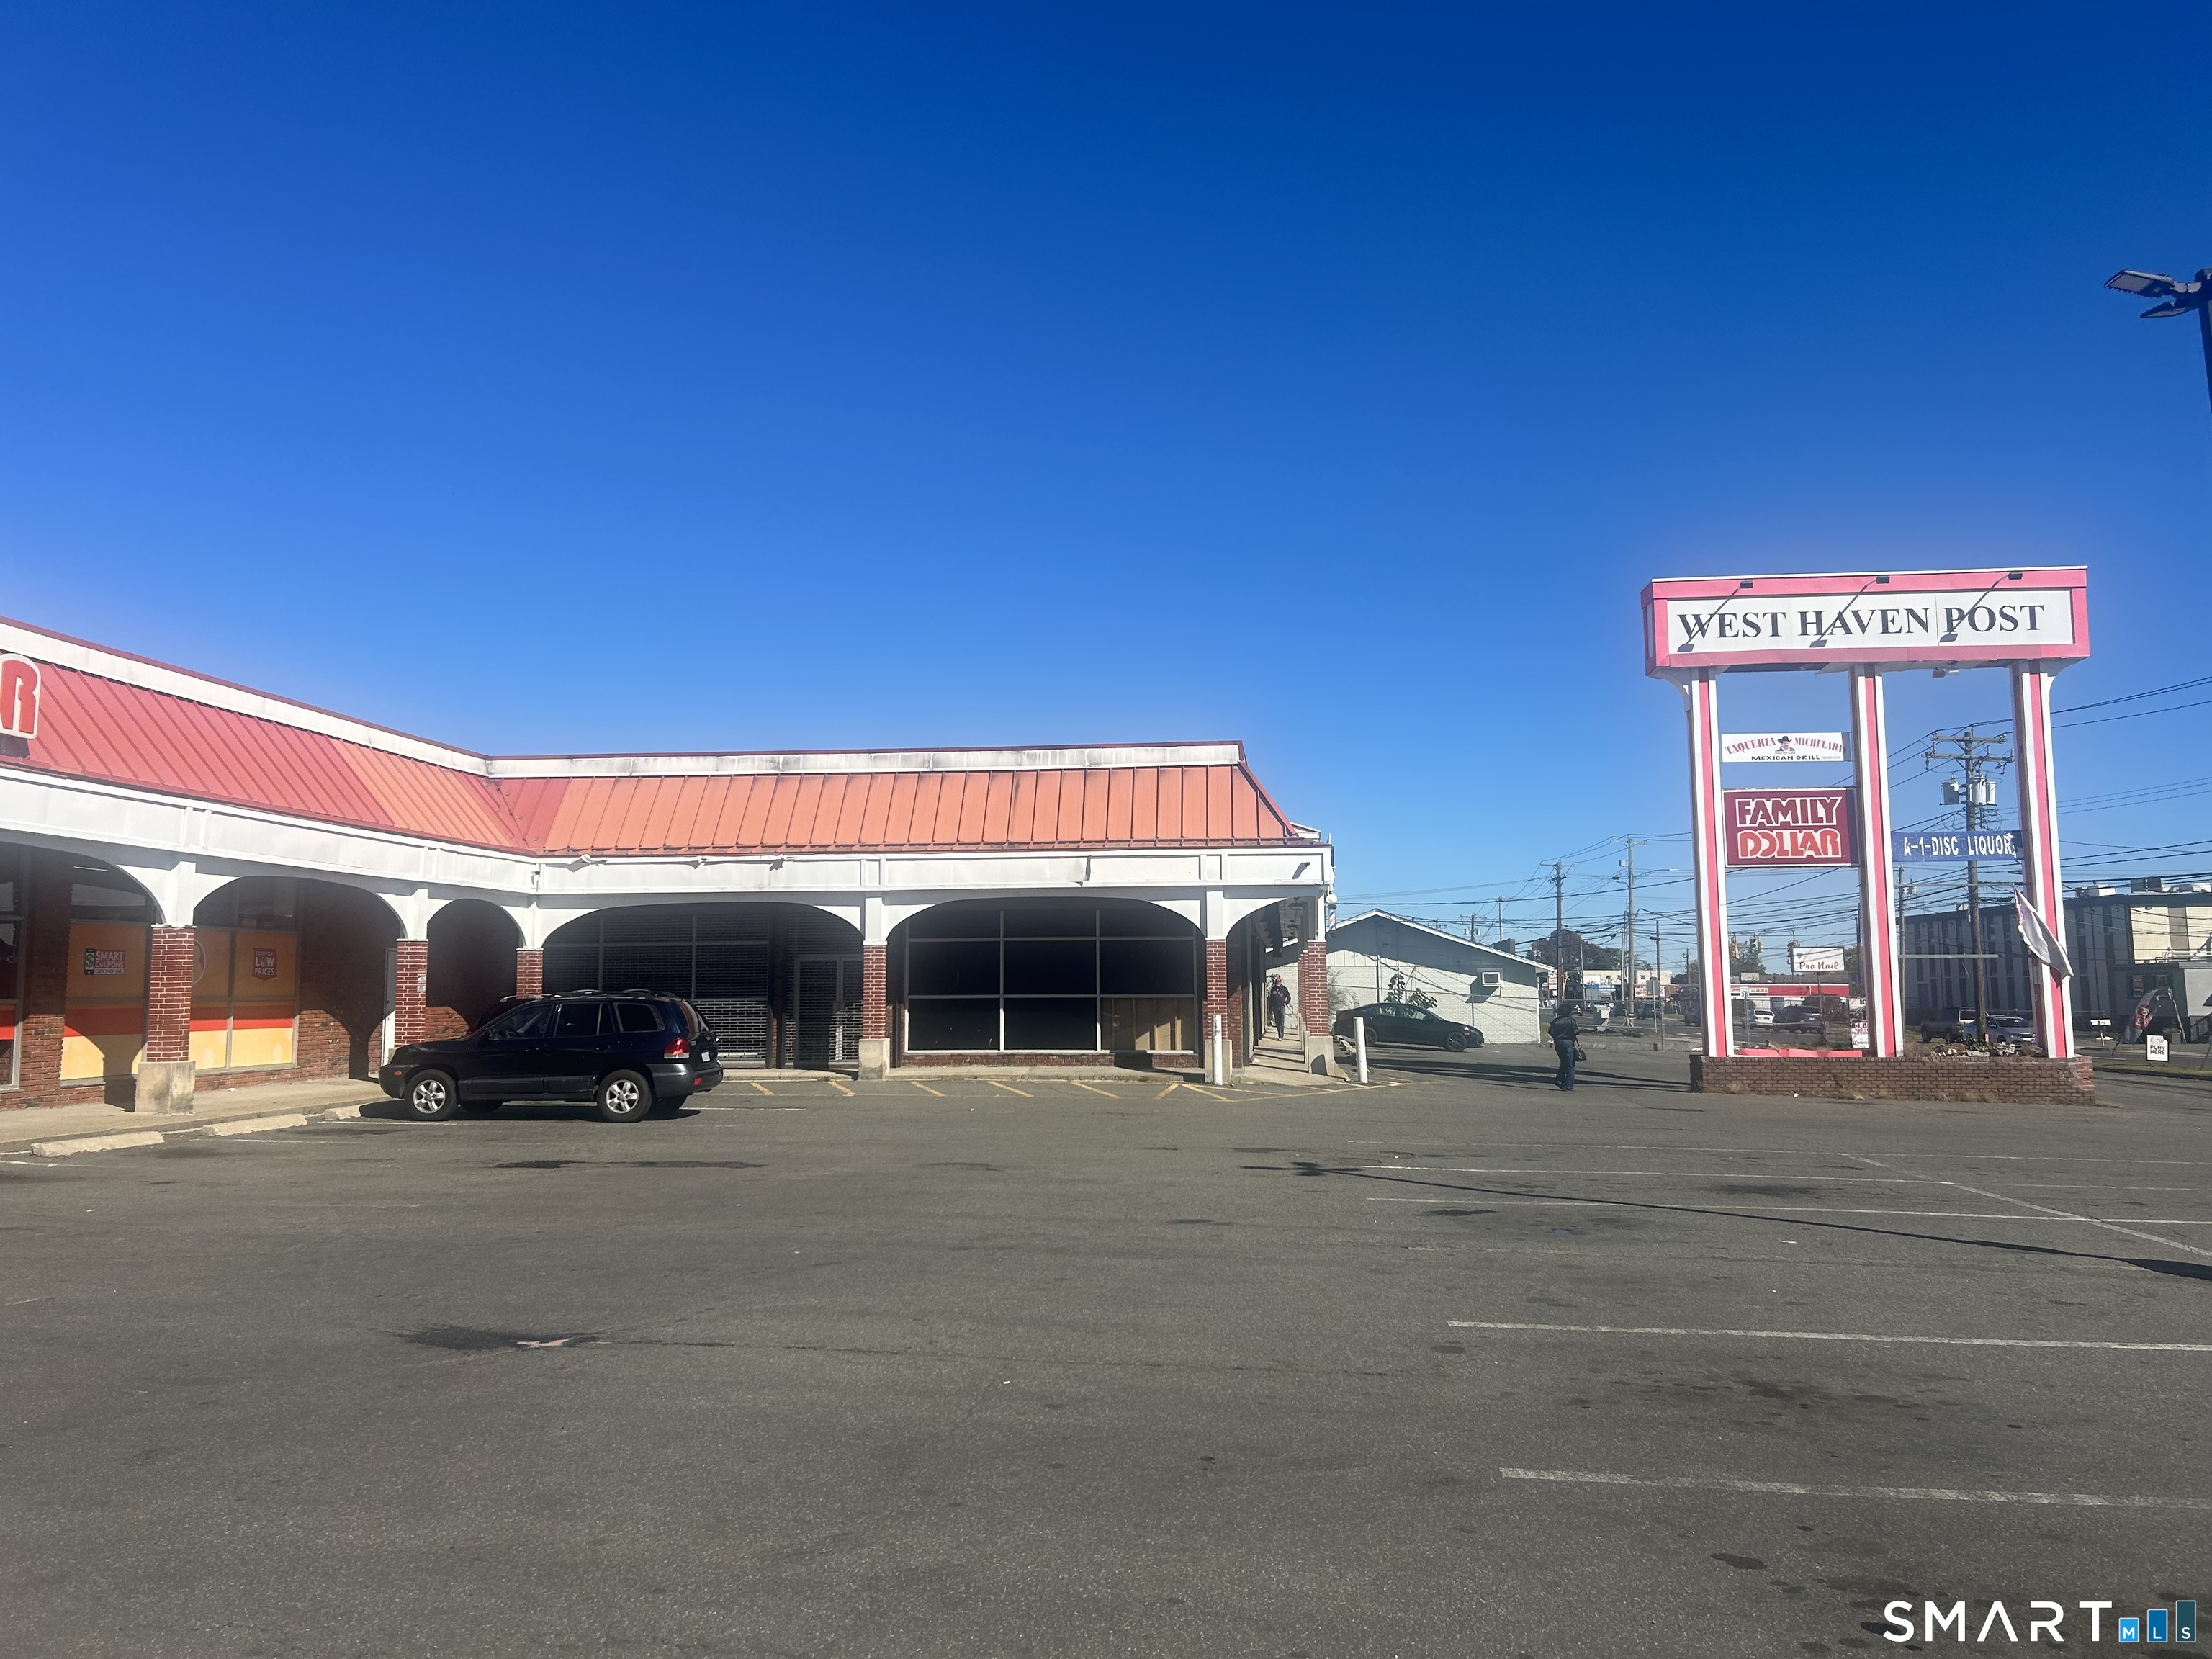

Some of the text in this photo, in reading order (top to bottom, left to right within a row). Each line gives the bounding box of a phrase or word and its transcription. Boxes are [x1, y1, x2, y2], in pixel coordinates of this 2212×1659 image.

[1677, 604, 2045, 640] WEST HAVEN POST
[1725, 737, 1776, 755] TAQUERIA
[1735, 796, 1843, 827] FAMILY
[1737, 828, 1842, 859] DOLLAR
[1903, 835, 1959, 856] A-1-DISC
[96, 950, 124, 961] SMART
[255, 956, 275, 967] LOW
[1799, 961, 1838, 970] Pro Nail
